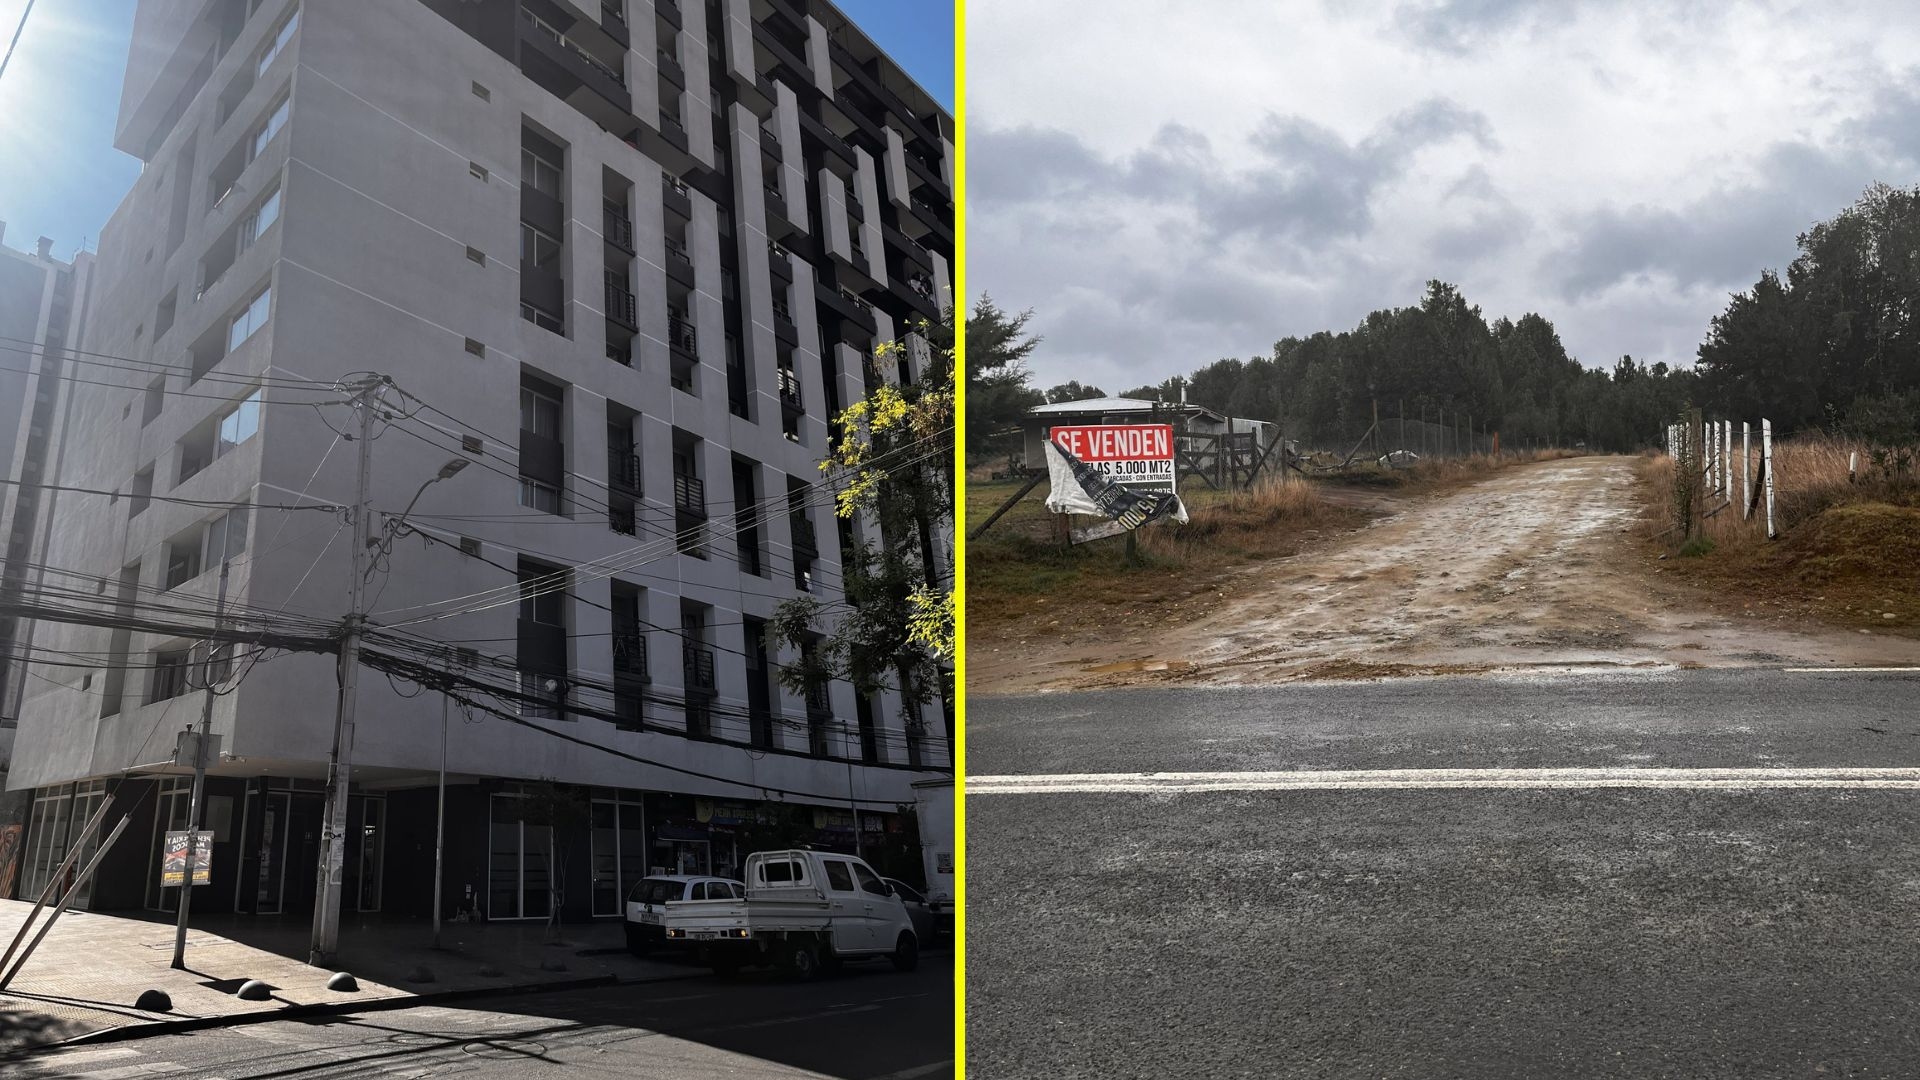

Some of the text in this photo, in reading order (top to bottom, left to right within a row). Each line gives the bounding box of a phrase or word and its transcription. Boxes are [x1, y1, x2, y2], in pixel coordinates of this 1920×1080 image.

[1057, 429, 1168, 458] SE VENDEN
[1115, 461, 1146, 475] 5.000
[1149, 460, 1171, 474] MT2
